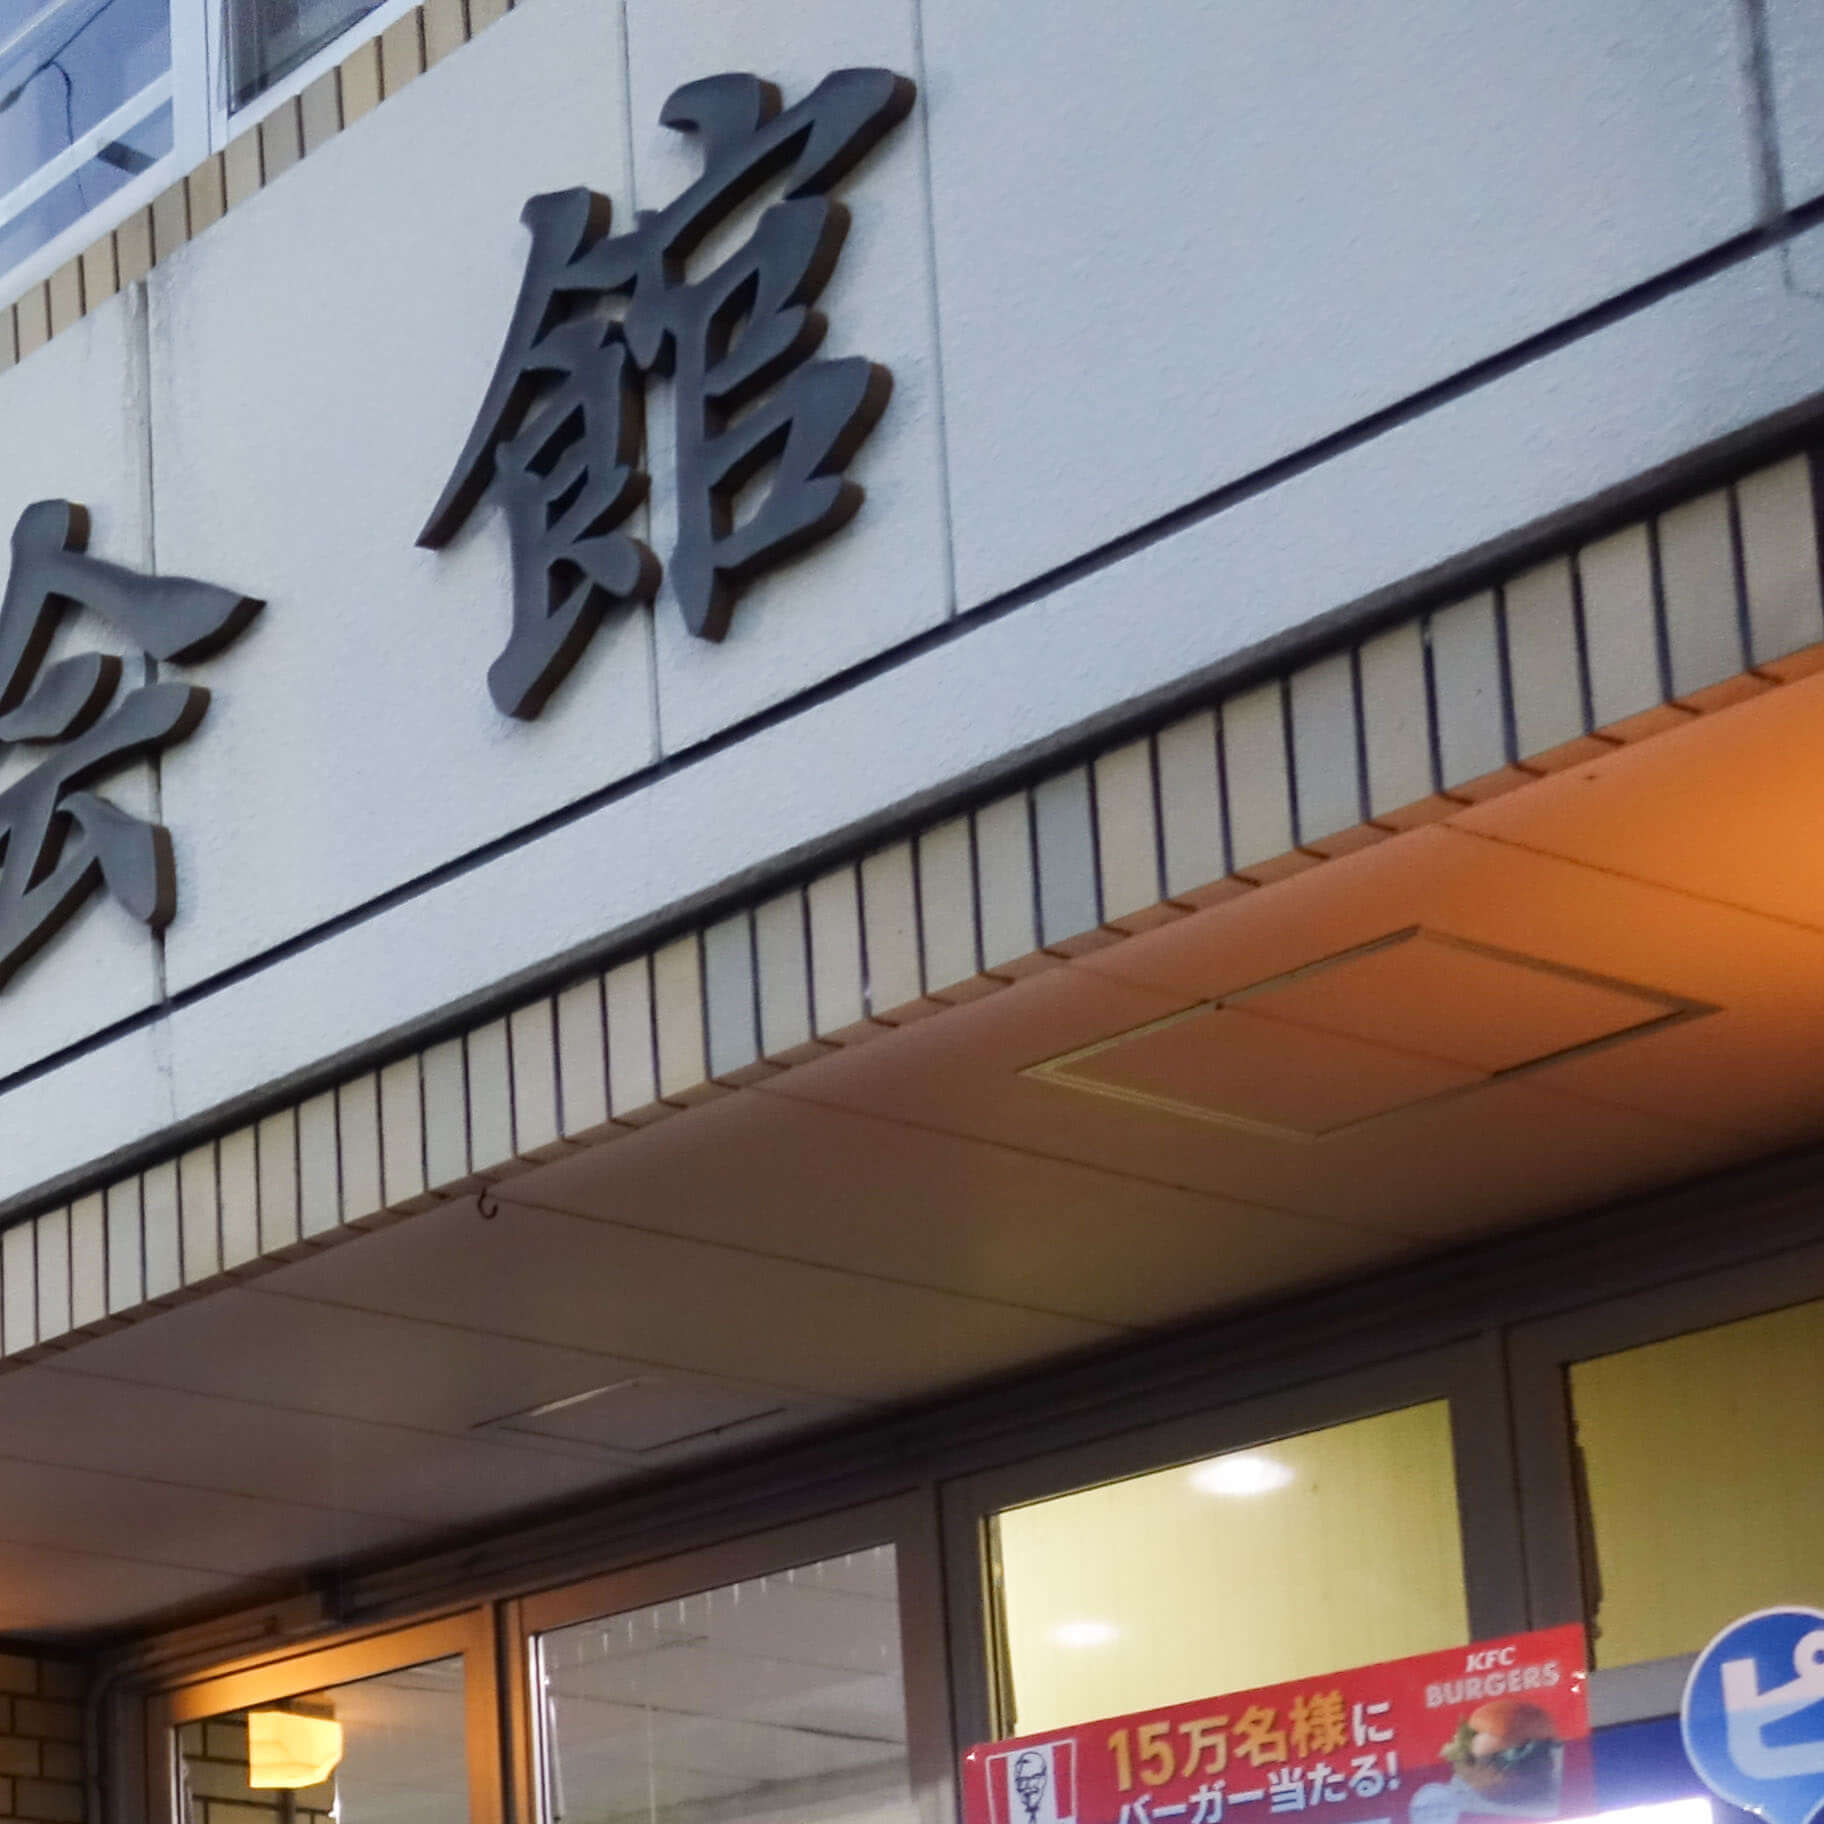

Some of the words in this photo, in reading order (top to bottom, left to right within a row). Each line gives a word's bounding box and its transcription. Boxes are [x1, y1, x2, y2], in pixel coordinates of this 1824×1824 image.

[1465, 1645, 1516, 1673] KFC
[1424, 1661, 1560, 1708] BURGERS
[1107, 1690, 1394, 1791] 15万名様に
